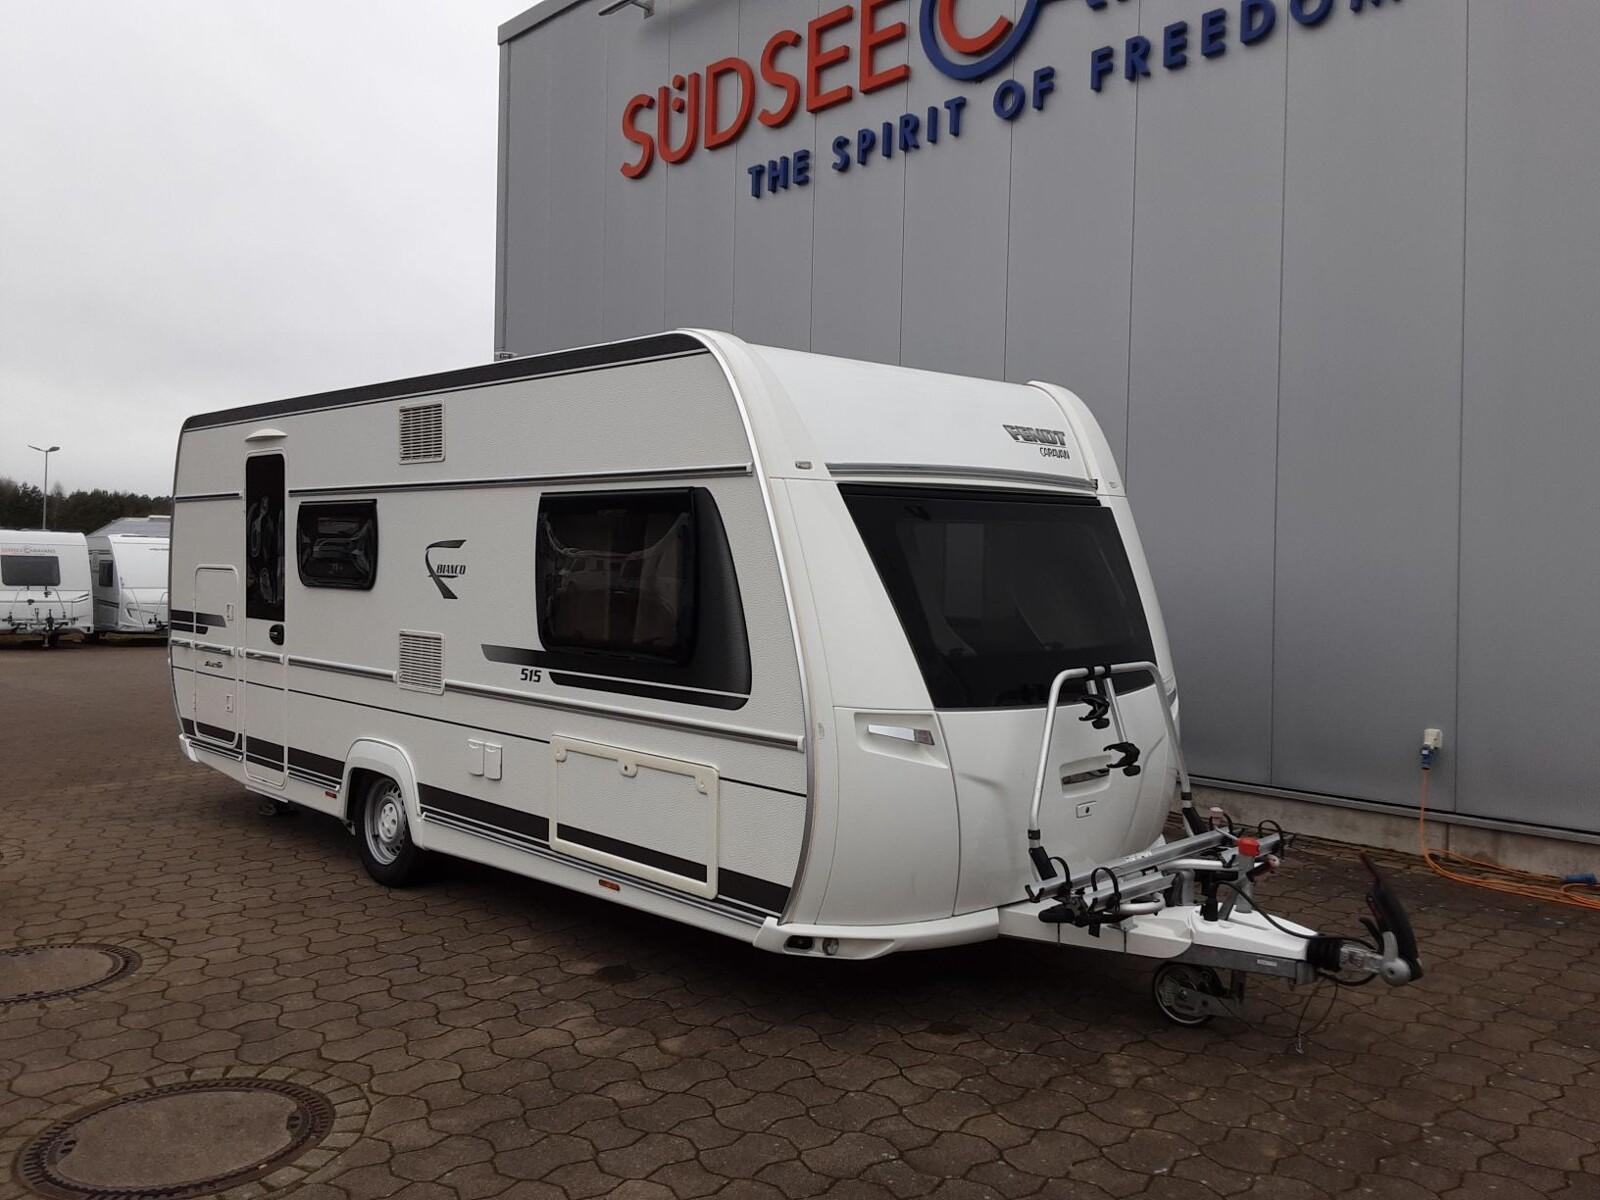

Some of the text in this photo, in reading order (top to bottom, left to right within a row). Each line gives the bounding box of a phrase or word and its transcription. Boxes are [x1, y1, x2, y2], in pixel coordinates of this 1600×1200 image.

[748, 149, 811, 198] THE
[832, 96, 967, 172] SPIRIT
[993, 66, 1056, 121] OF
[1090, 0, 1397, 92] FREEDO
[1002, 424, 1066, 446] FENDT
[436, 564, 466, 575] BIANCO
[519, 668, 542, 683] 515
